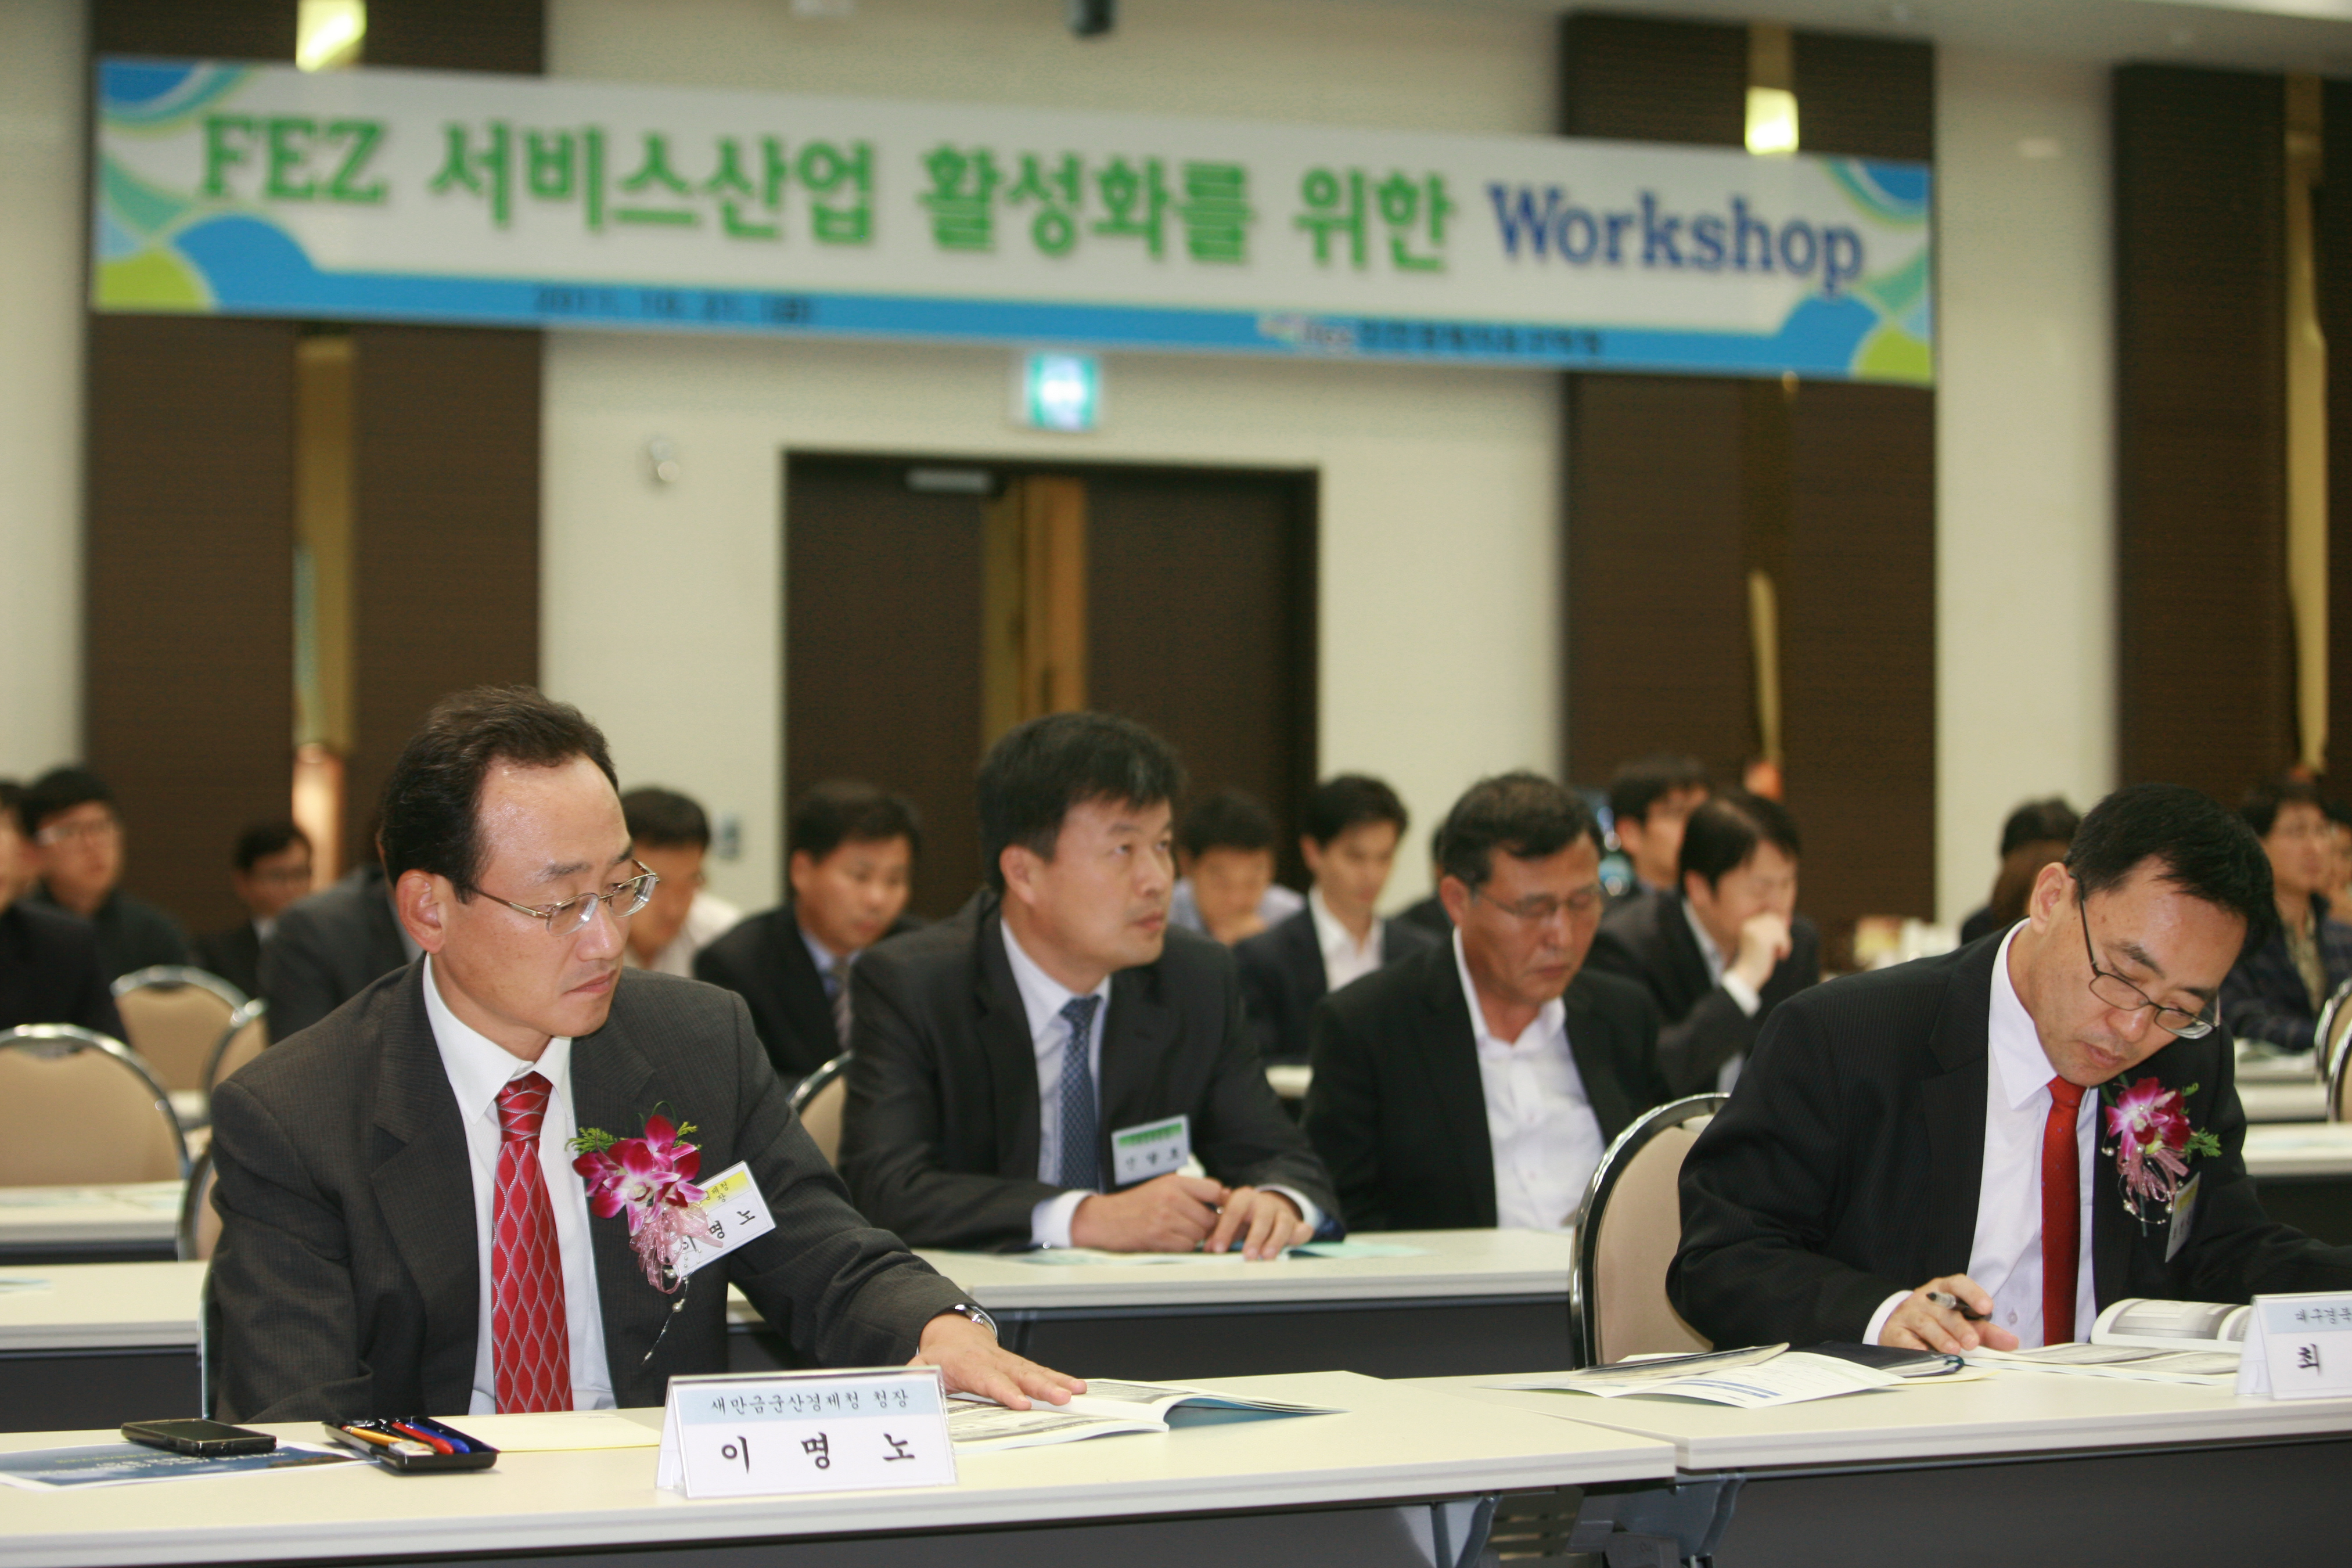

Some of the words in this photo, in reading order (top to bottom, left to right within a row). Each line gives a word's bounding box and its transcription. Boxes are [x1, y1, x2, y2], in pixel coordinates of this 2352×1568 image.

[200, 115, 388, 204] FEZ
[430, 121, 874, 246] 서비스산업
[916, 141, 1257, 265] 활성화를
[1294, 167, 1456, 272] 위한
[1487, 181, 1868, 297] Workshop
[2297, 1343, 2321, 1376] 최
[711, 1391, 859, 1415] 새만금군산경제청
[873, 1389, 909, 1408] 청장
